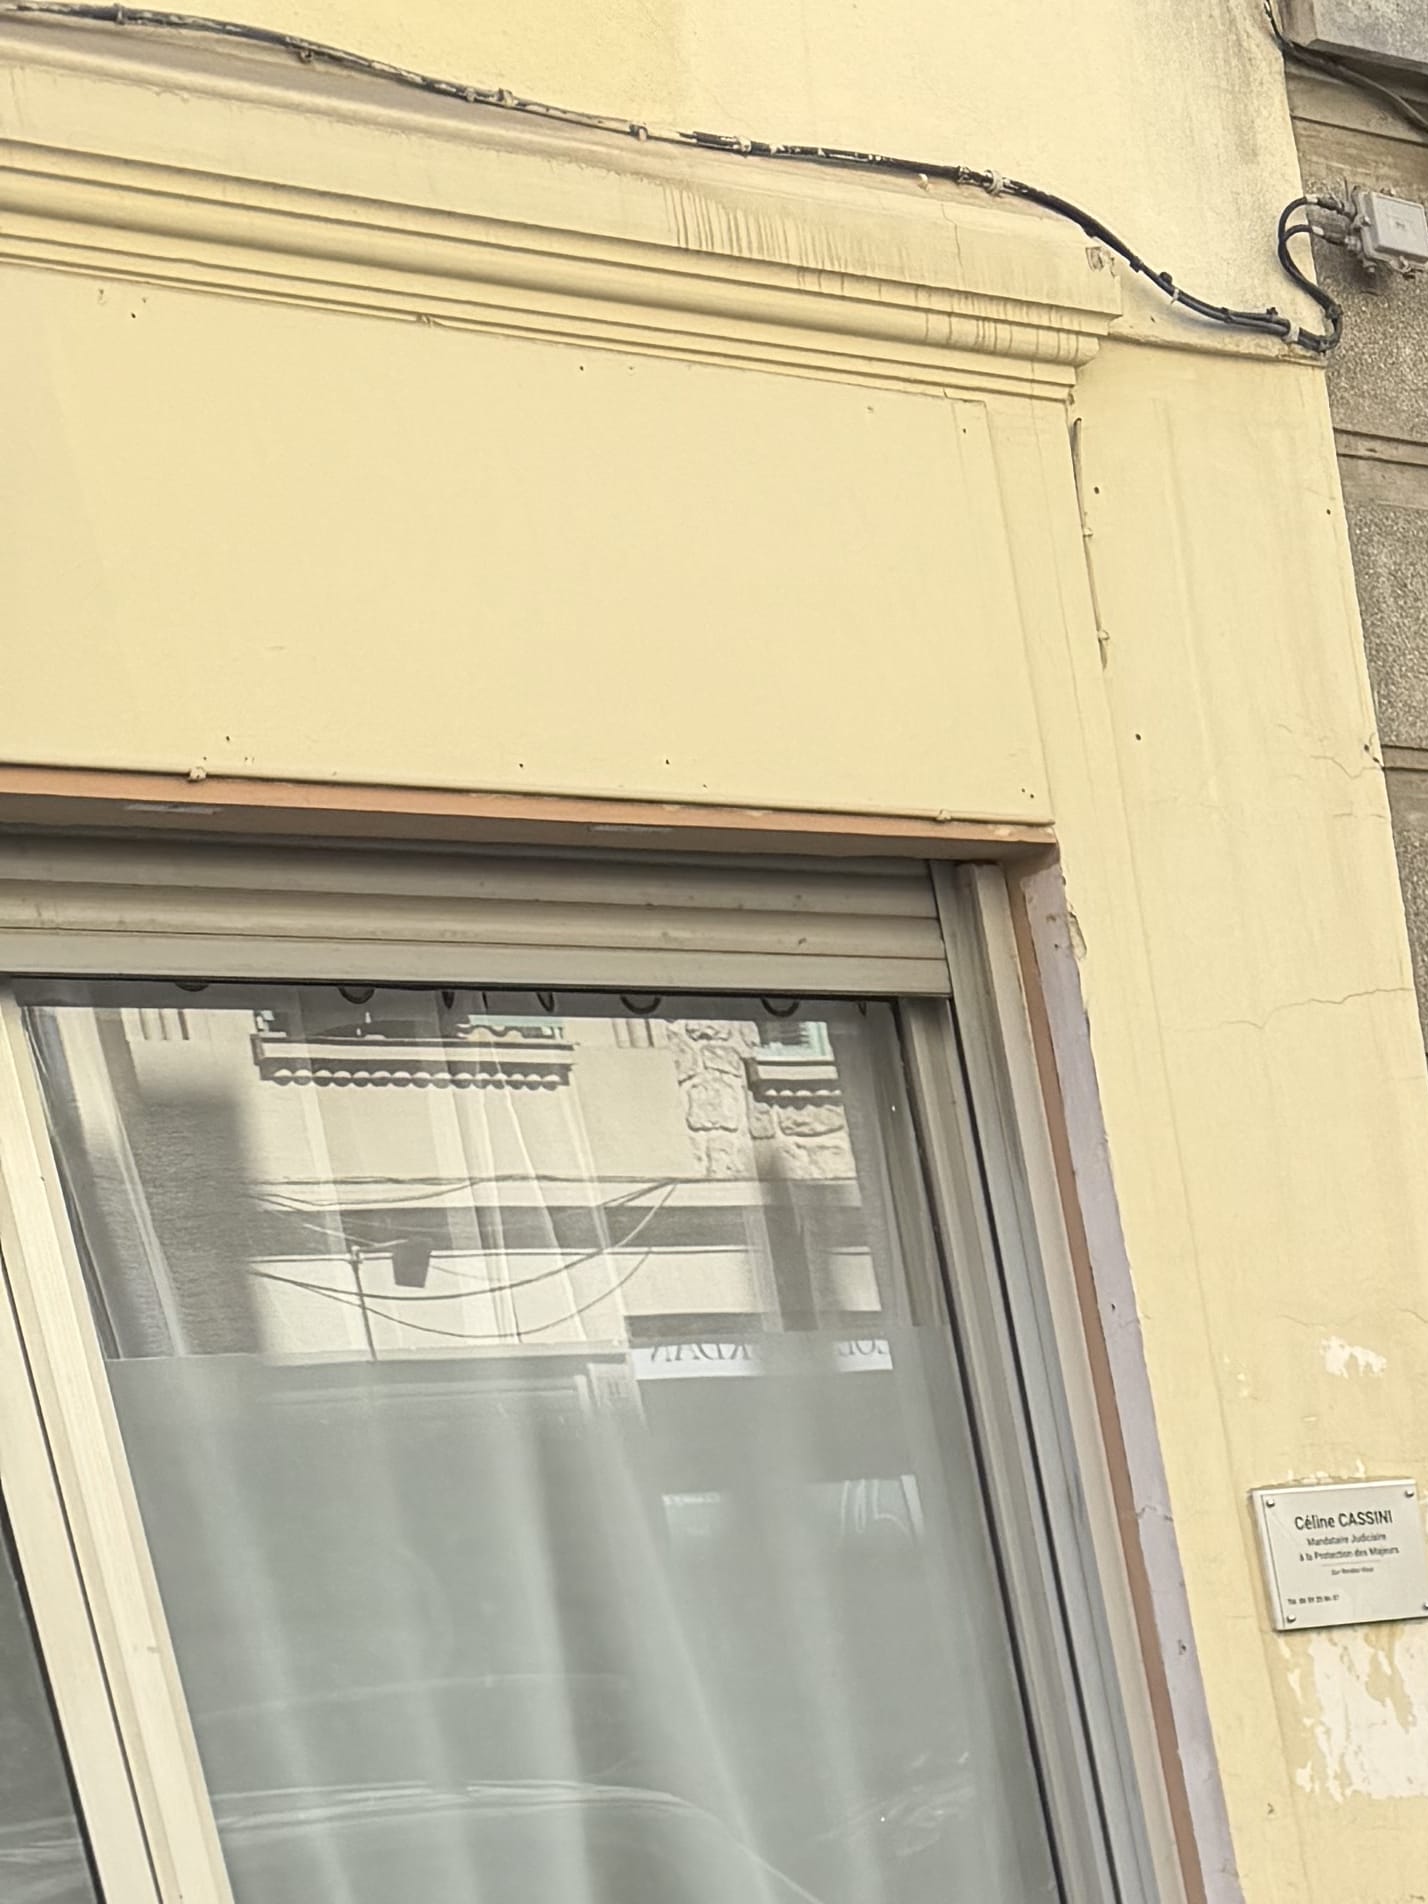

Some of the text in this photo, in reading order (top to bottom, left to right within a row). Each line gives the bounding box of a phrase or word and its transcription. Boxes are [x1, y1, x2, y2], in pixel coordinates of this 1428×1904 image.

[1294, 1510, 1392, 1530] Céline CASSINI
[1314, 1551, 1353, 1559] Protection
[1355, 1548, 1368, 1557] des
